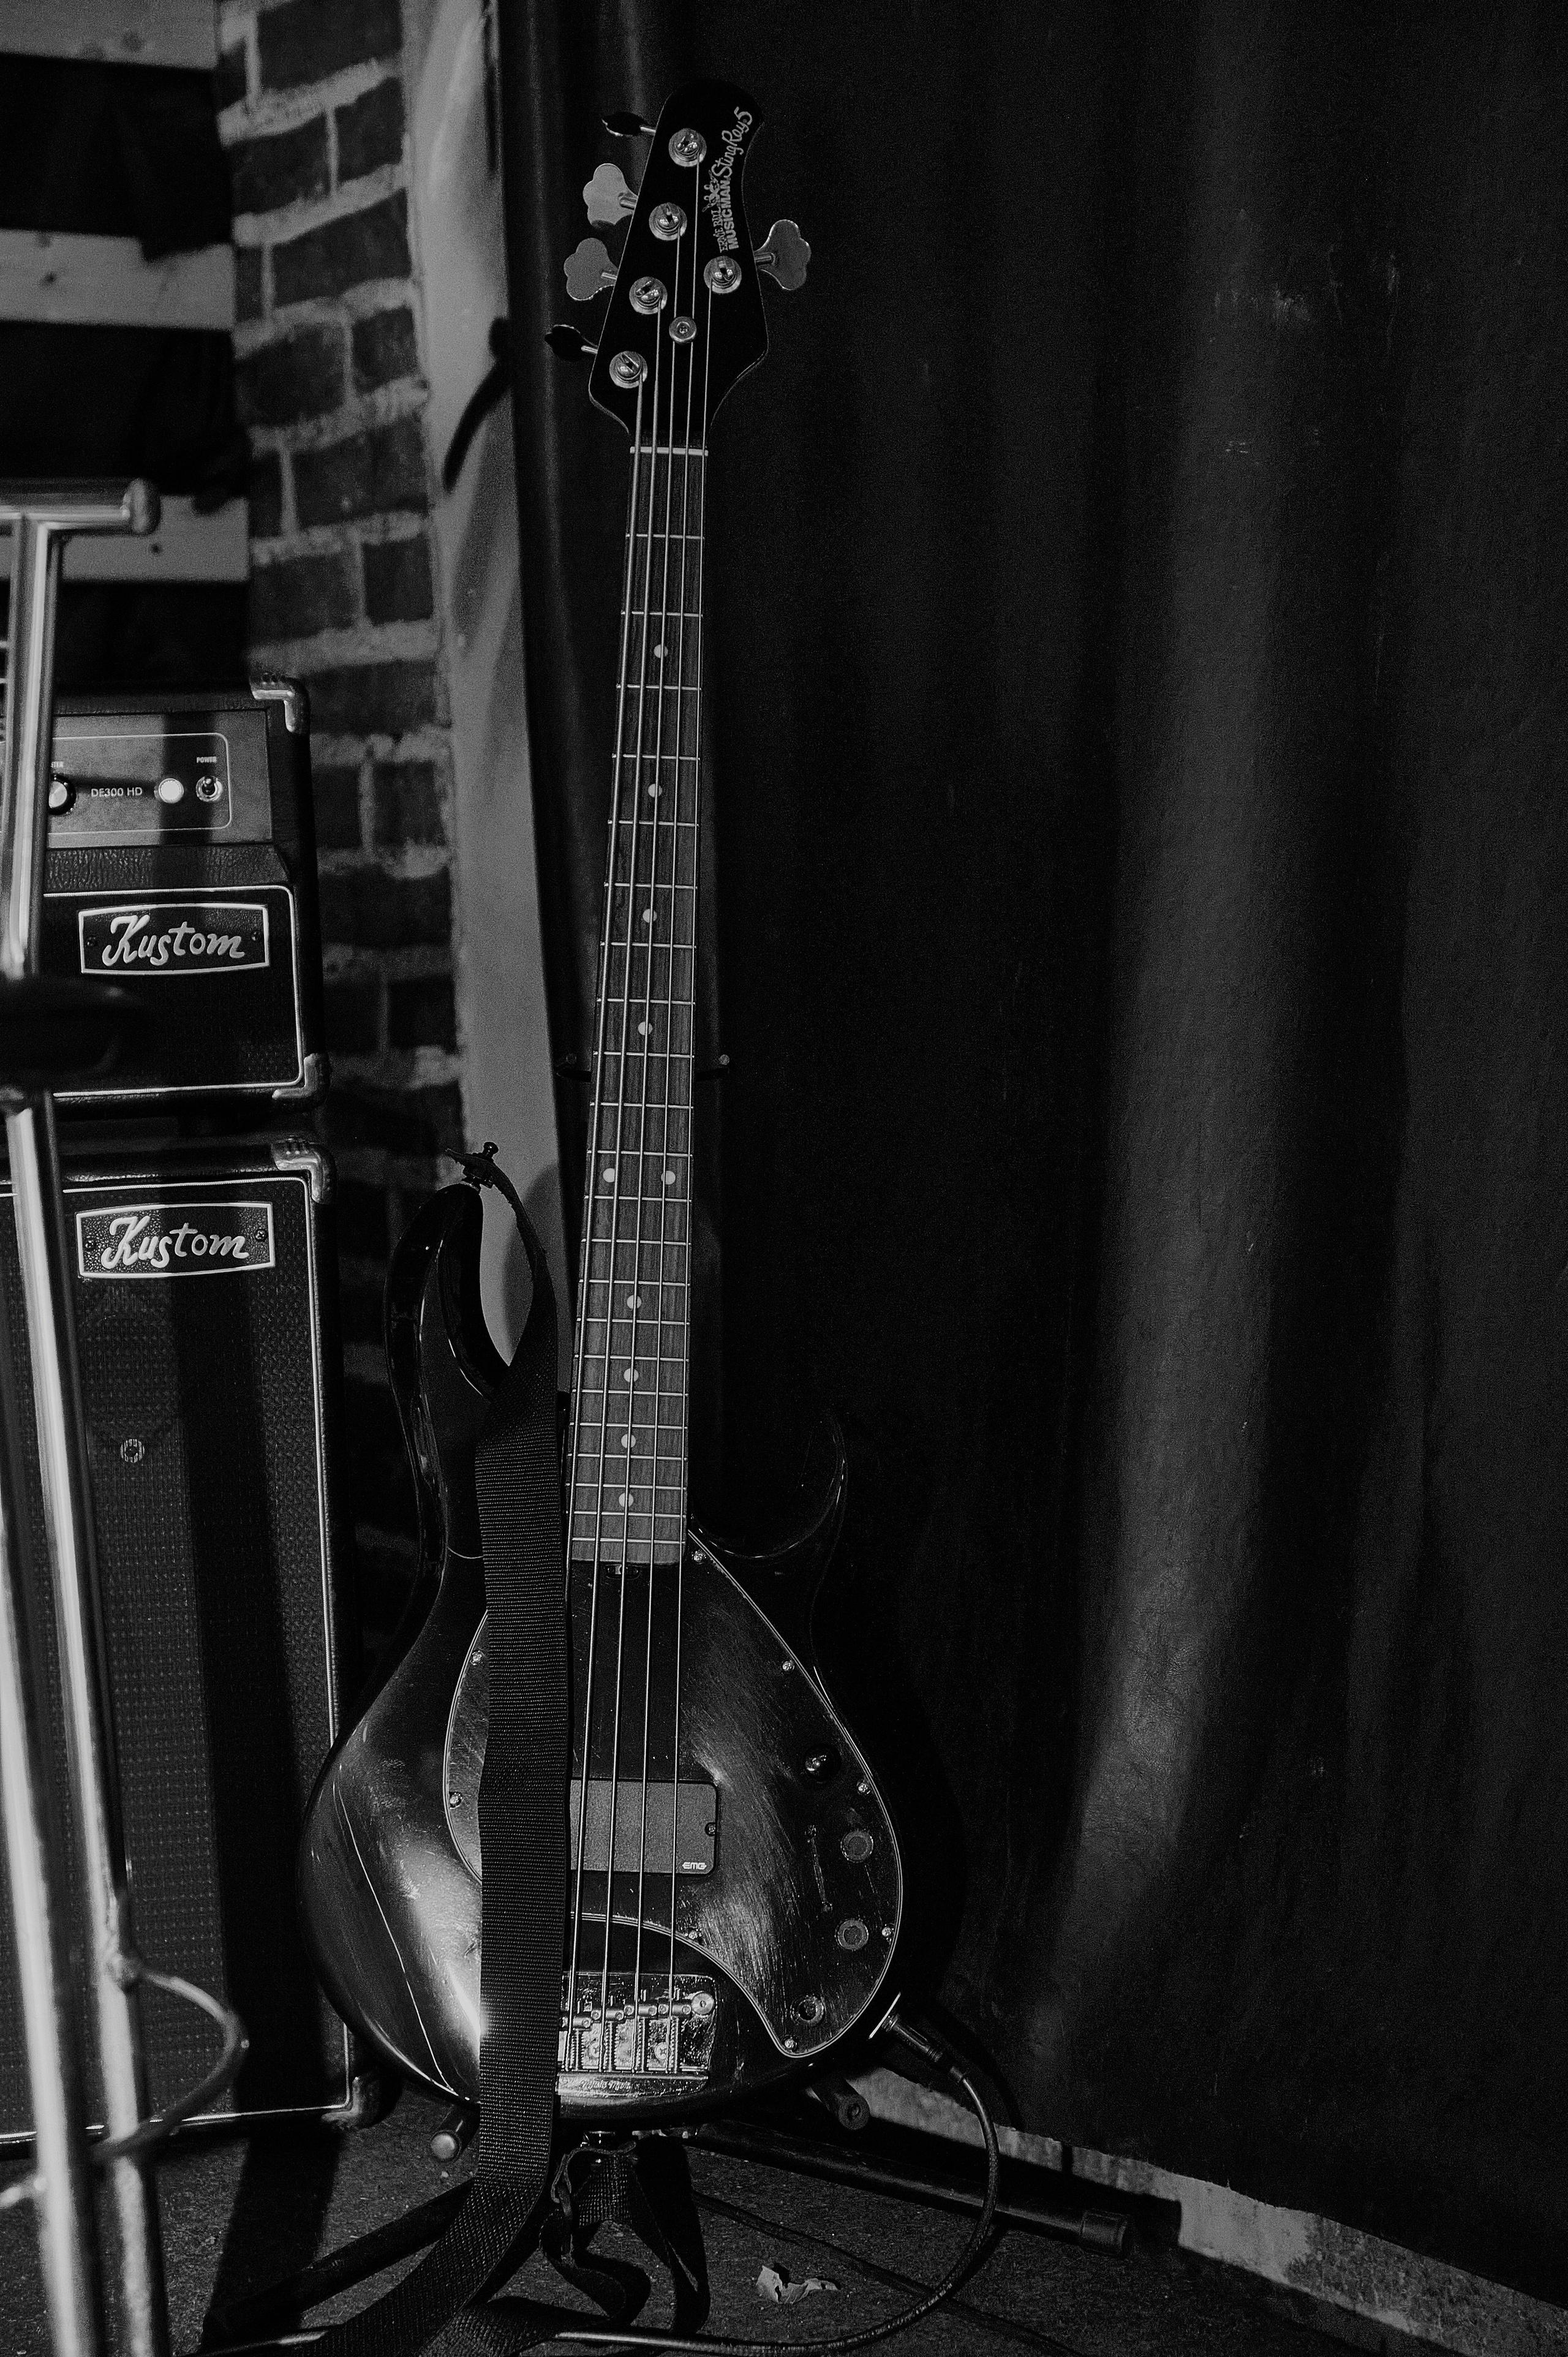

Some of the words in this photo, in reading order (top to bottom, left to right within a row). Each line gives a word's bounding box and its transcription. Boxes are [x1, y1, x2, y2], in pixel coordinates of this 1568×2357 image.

[710, 206, 723, 227] BALL
[712, 227, 729, 253] ERNIE
[91, 787, 124, 798] DE300
[127, 786, 143, 796] HD
[101, 914, 245, 967] Kustom
[100, 1215, 250, 1270] Kustom
[682, 1861, 707, 1870] EMG
